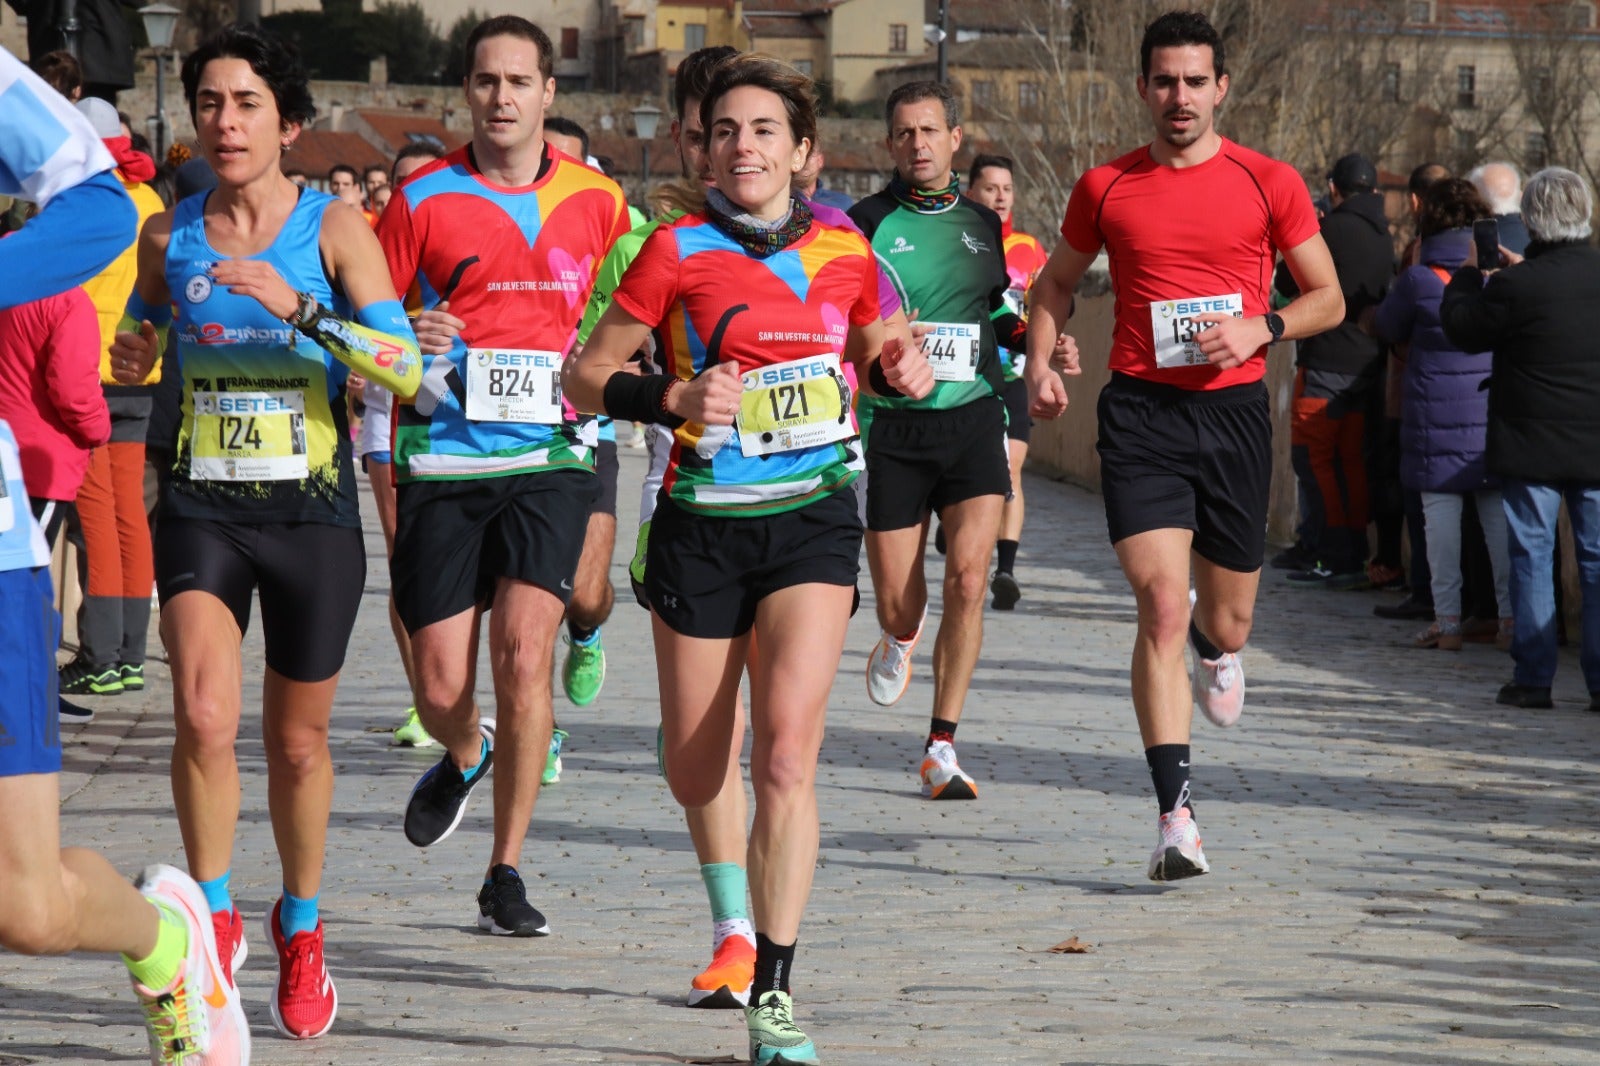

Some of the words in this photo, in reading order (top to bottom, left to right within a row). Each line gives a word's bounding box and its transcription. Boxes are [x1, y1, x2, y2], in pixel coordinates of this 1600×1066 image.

[487, 282, 502, 292] SAN
[502, 281, 537, 291] SILVESTRE
[1176, 300, 1234, 314] SETEL
[758, 331, 773, 341] SAN
[774, 332, 811, 342] SILVESTRE
[495, 353, 554, 368] SETEL
[762, 361, 829, 385] SETEL
[226, 376, 252, 387] FRAN
[253, 376, 309, 388] HERNÁNDEZ
[489, 368, 535, 397] 824
[219, 397, 292, 413] SETEL
[769, 383, 809, 421] 121
[219, 416, 262, 450] 124
